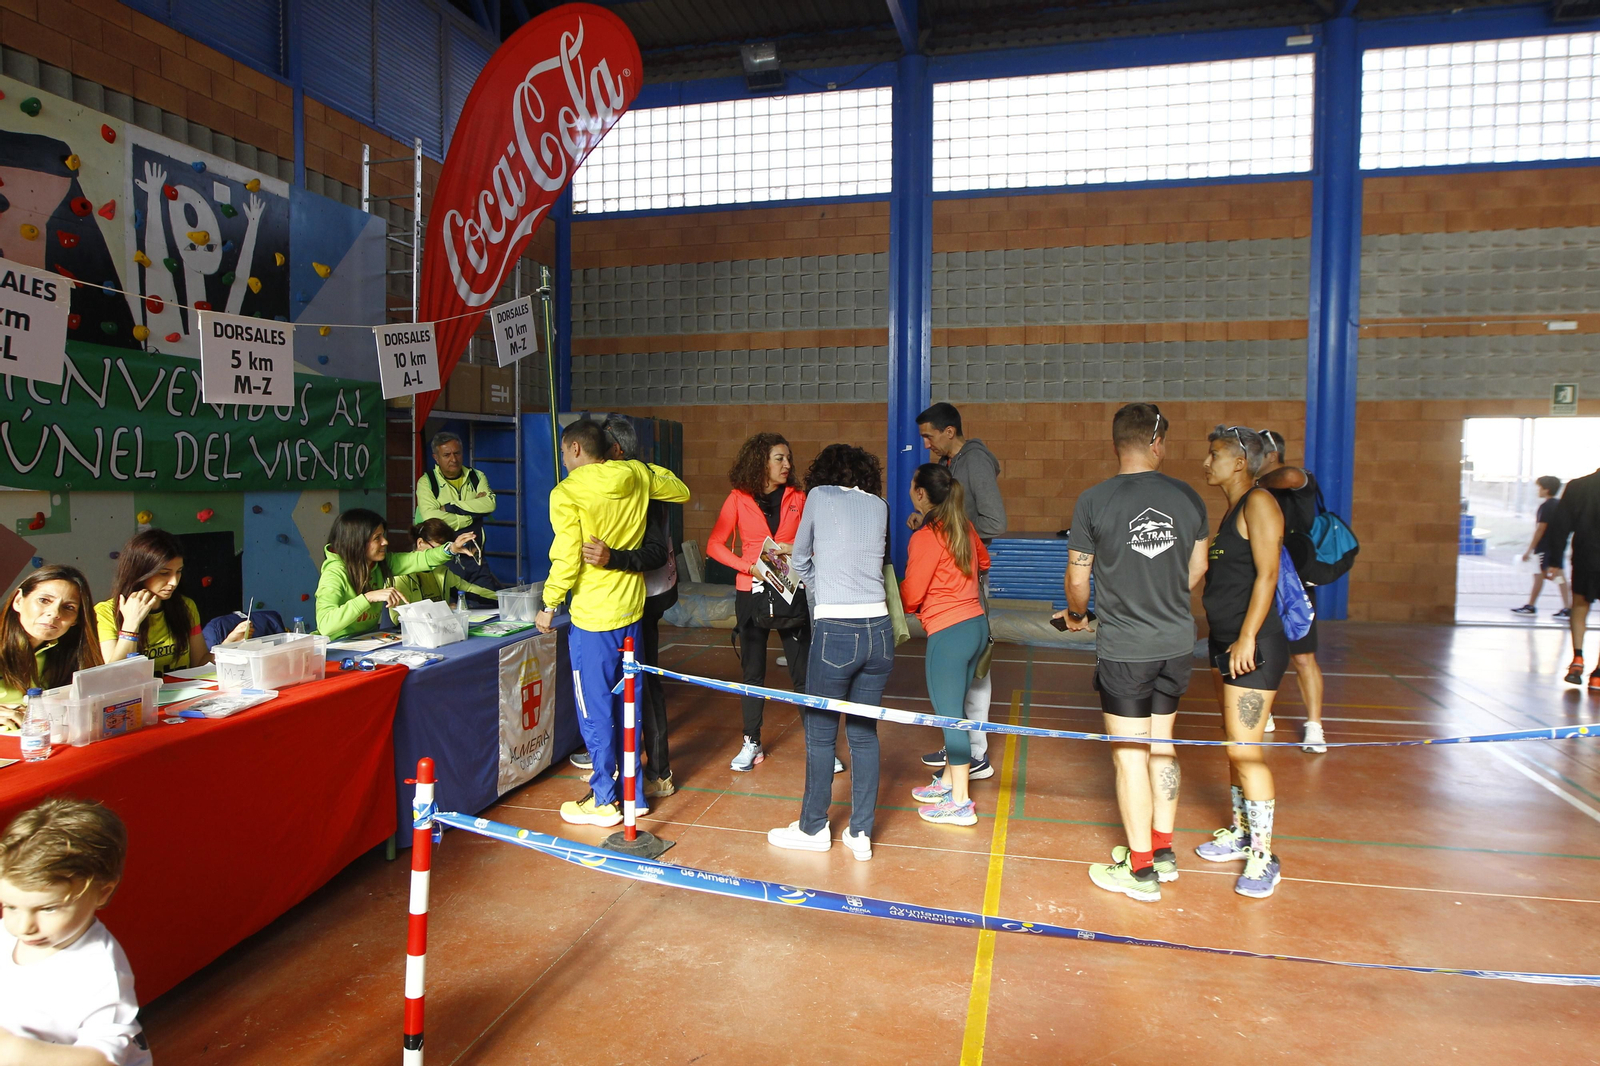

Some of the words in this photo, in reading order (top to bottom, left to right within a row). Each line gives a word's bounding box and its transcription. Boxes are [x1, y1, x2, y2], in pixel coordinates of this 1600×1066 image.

[443, 16, 625, 307] Coca-Cola
[0, 270, 57, 302] ALES
[497, 303, 529, 324] DORSALES
[213, 321, 286, 345] DORSALES
[384, 330, 431, 347] DORSALES
[504, 327, 514, 340] 10
[516, 323, 528, 336] km
[509, 337, 528, 356] M-Z
[231, 350, 242, 369] 5
[249, 351, 274, 372] km
[394, 352, 407, 369] 10
[410, 351, 427, 366] km
[233, 375, 273, 395] M-Z
[403, 370, 424, 388] A-L
[328, 388, 369, 428] AL
[1, 408, 157, 480] ÚNEL
[174, 431, 243, 481] DEL
[249, 435, 370, 481] VIENTO
[1131, 532, 1145, 543] AC
[1147, 530, 1174, 541] TRAIL
[889, 905, 975, 924] Ayuntamiento
